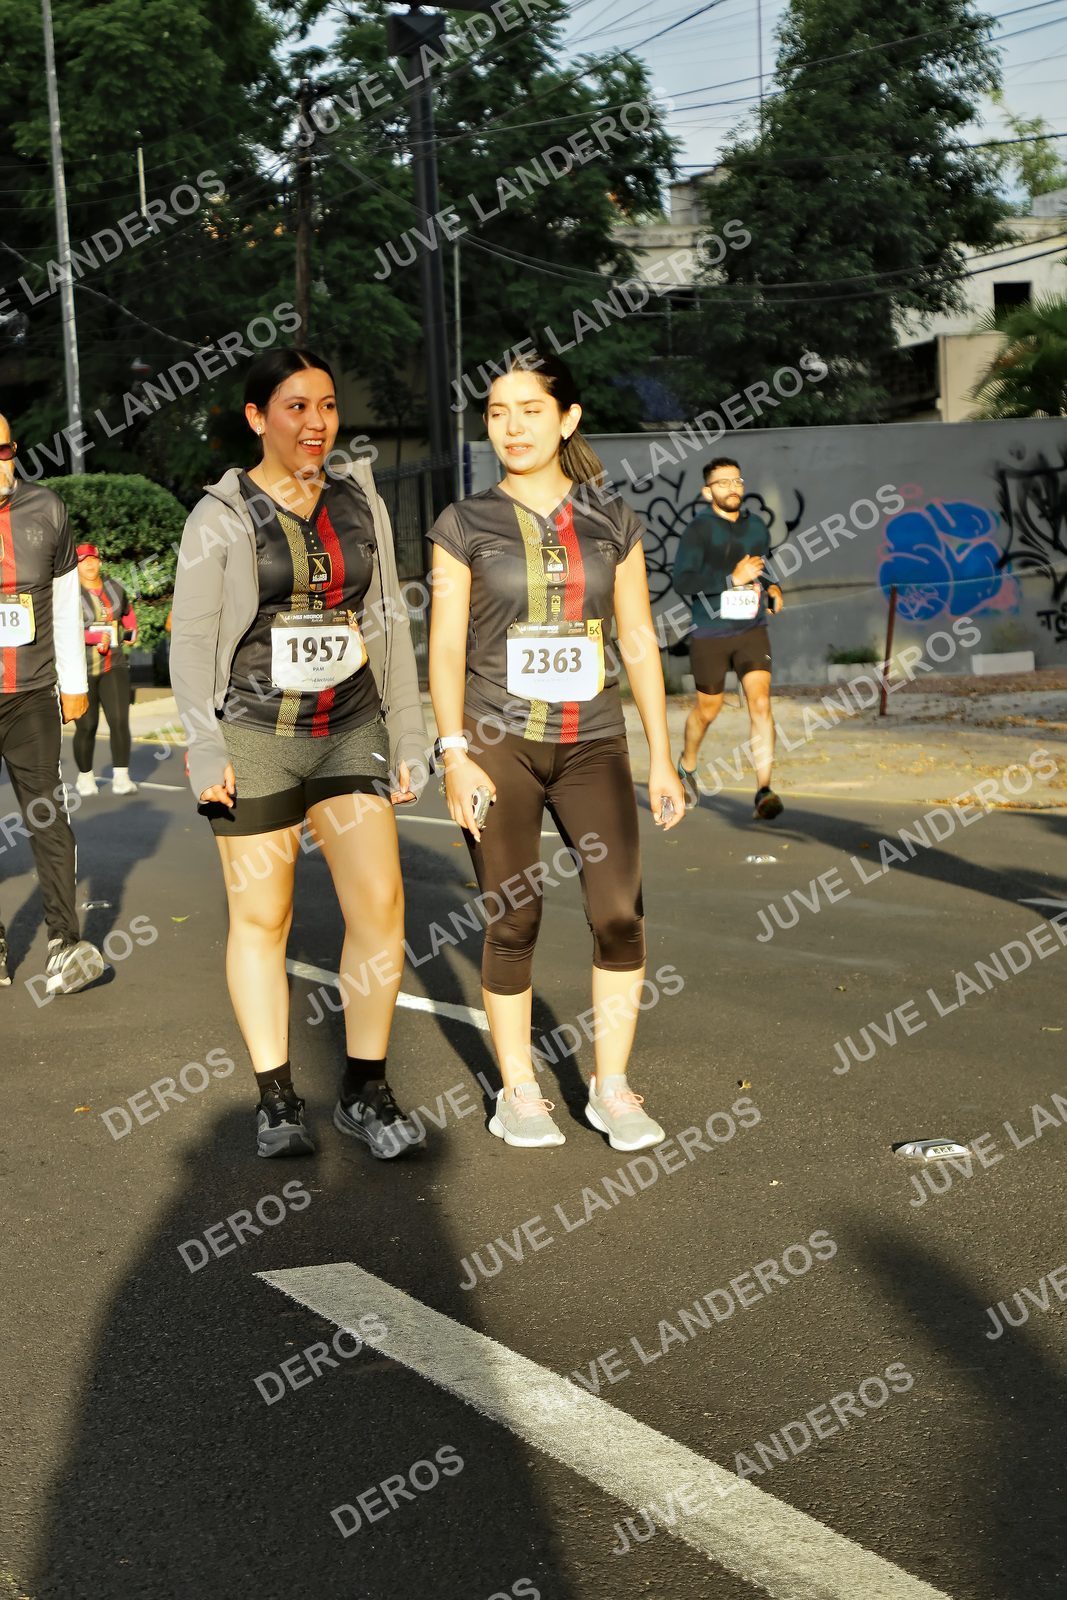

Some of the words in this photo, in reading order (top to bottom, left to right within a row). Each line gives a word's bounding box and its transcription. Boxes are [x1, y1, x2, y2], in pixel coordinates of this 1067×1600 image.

[589, 626, 600, 635] 5K
[287, 636, 349, 662] 1957
[521, 647, 582, 674] 2363
